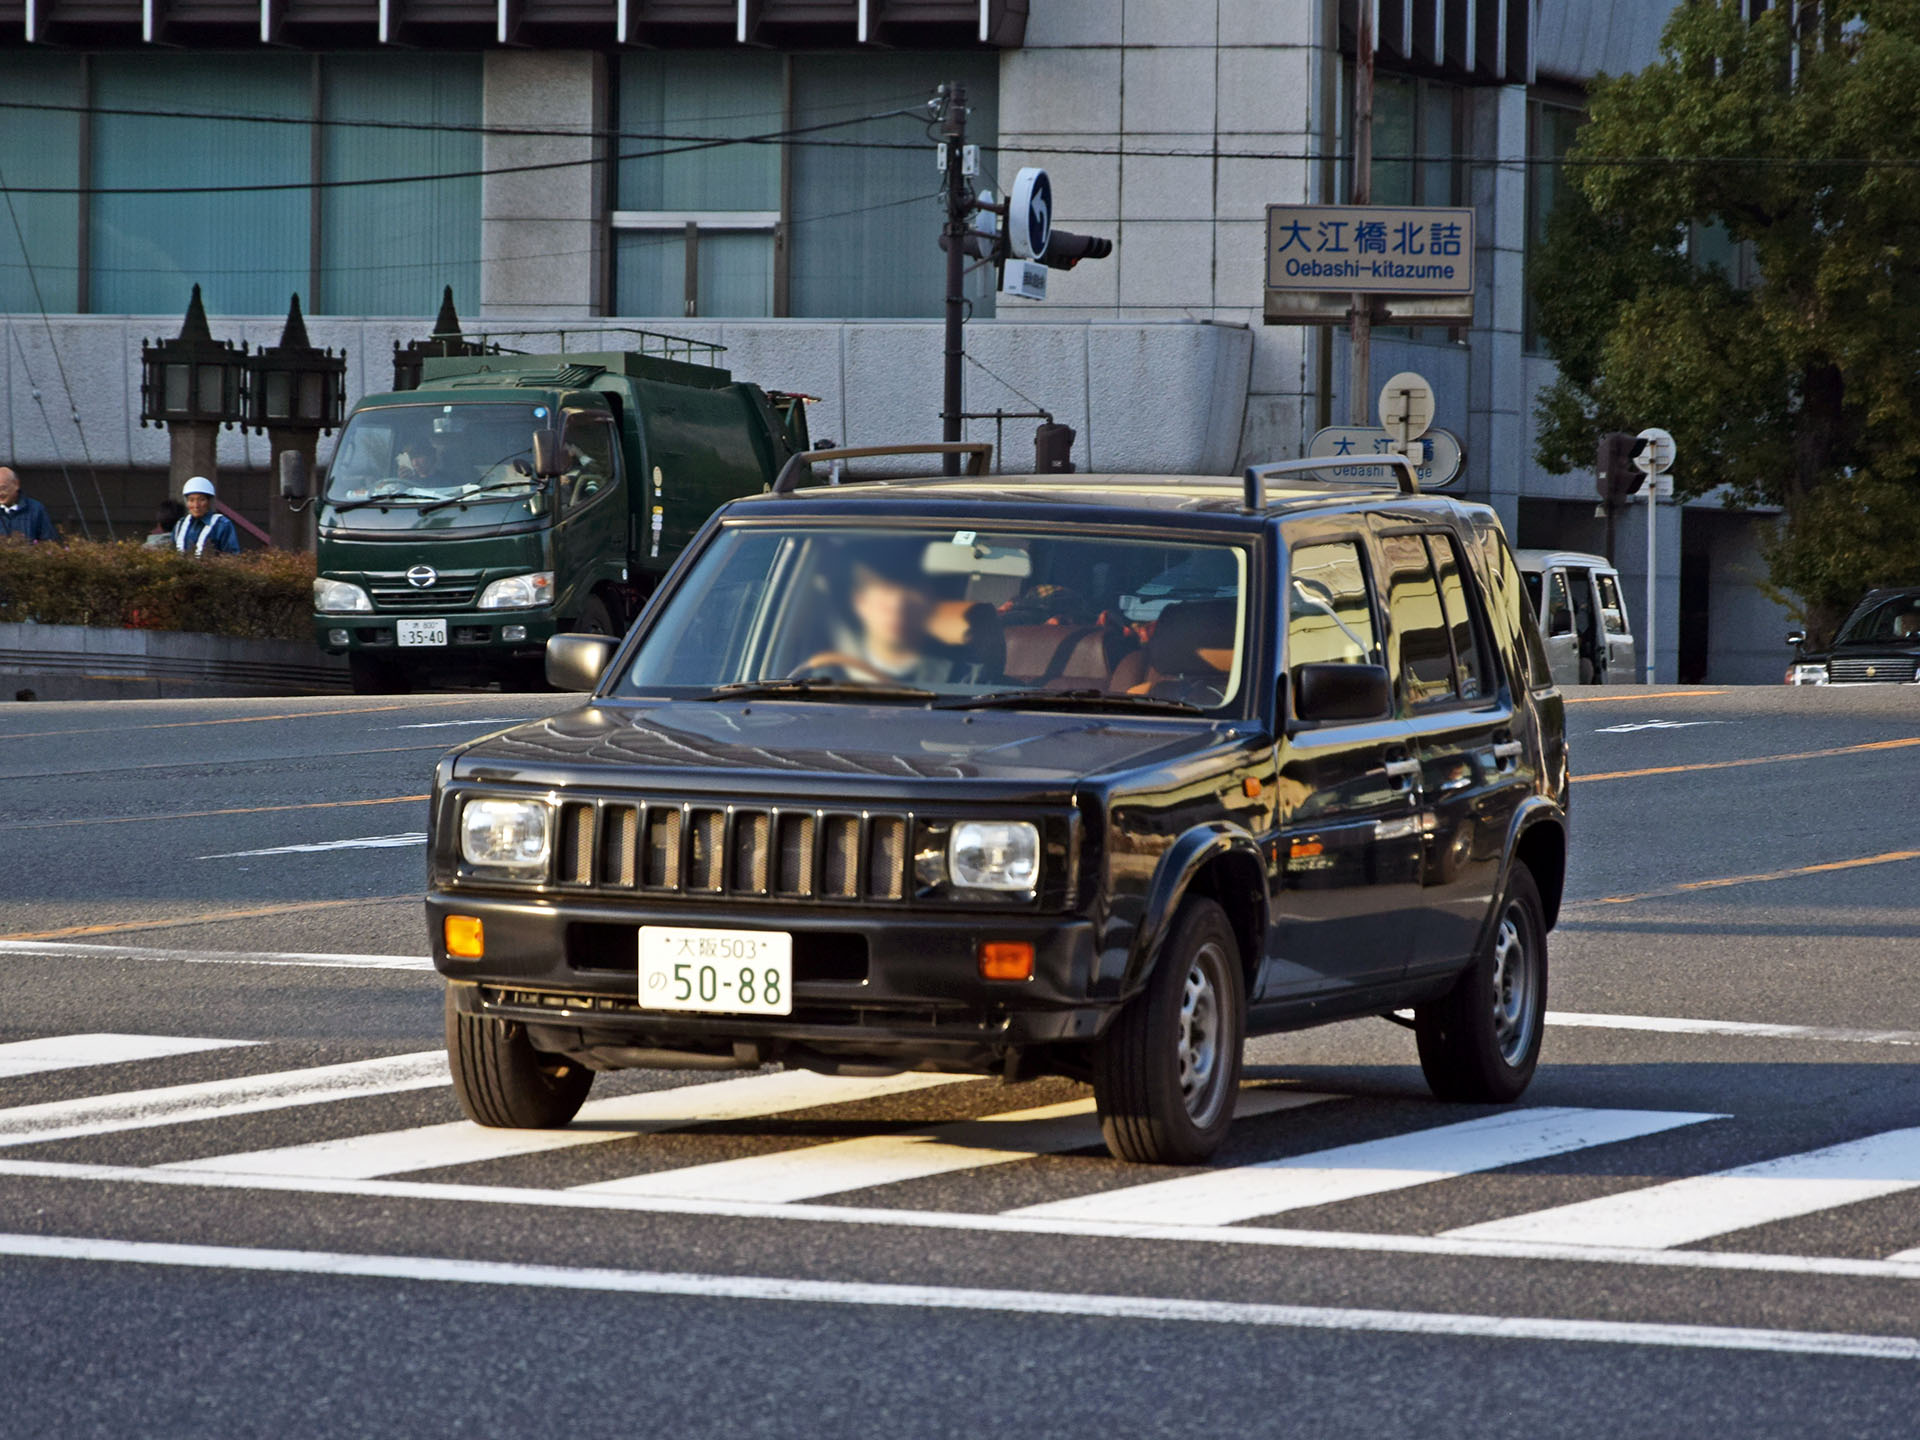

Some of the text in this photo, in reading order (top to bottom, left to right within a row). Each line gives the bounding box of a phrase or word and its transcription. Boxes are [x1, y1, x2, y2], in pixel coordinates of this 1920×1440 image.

[1278, 219, 1462, 256] 大江橋北詰
[1286, 258, 1455, 279] Oebashi-kitazume
[408, 630, 444, 644] 35-40
[674, 963, 781, 1005] 50-88
